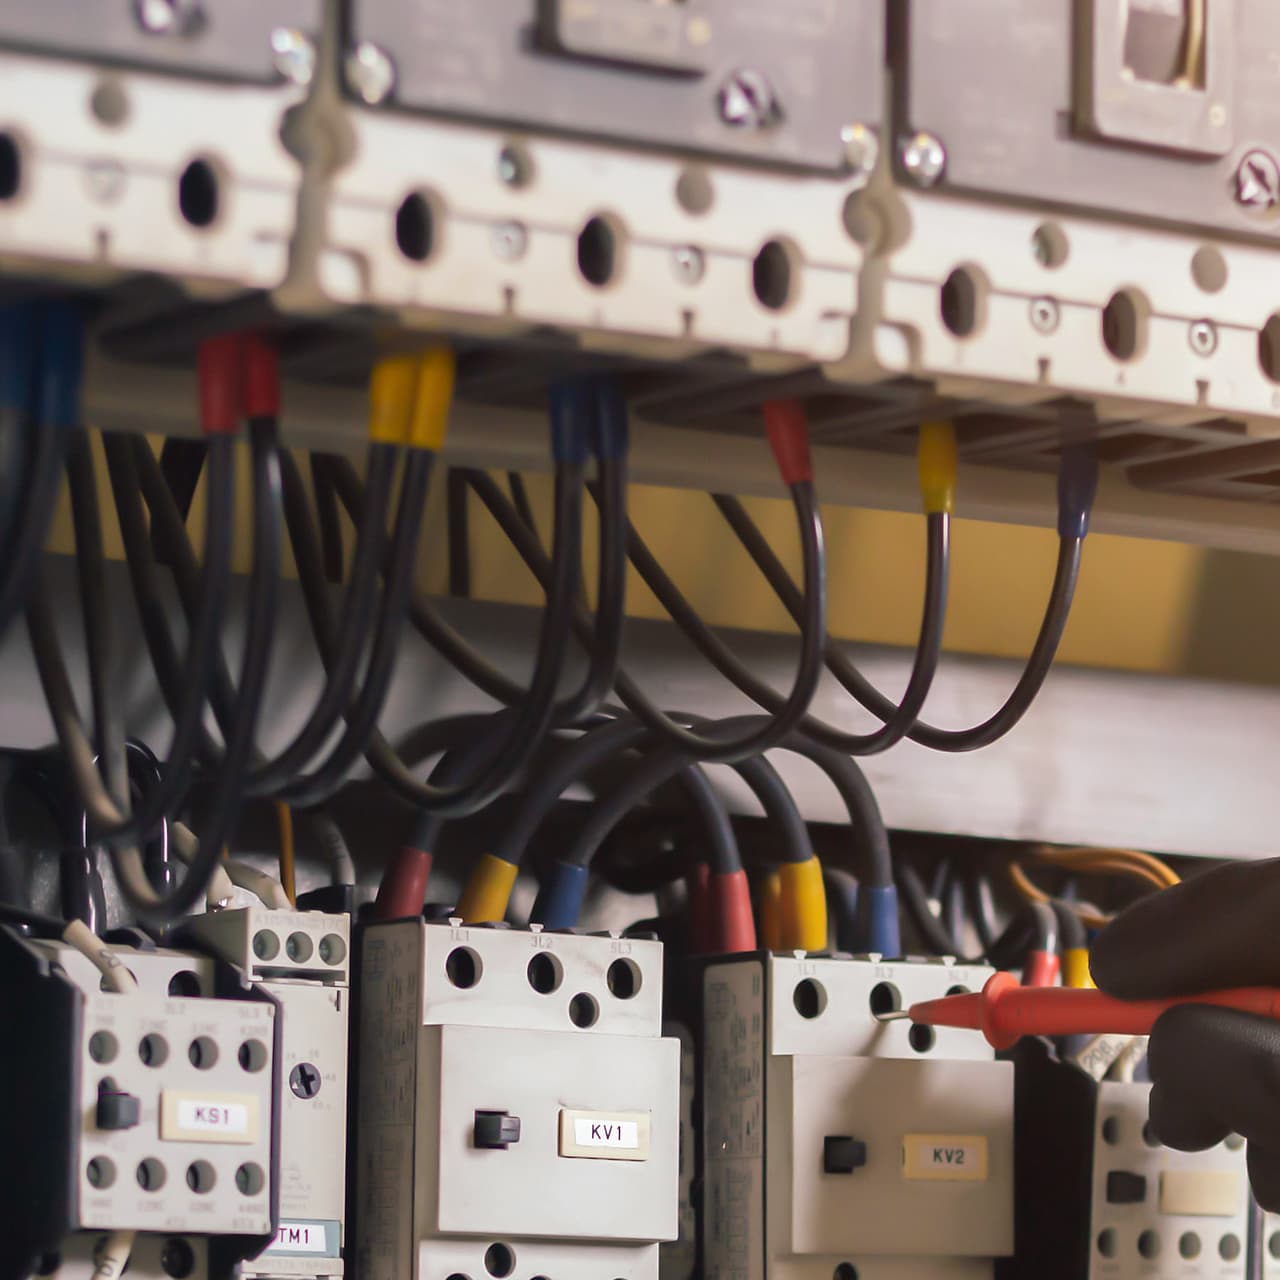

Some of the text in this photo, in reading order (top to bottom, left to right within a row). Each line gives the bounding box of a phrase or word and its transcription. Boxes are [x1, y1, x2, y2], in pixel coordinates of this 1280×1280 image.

[194, 1107, 230, 1124] KS1
[591, 1123, 622, 1141] KV1
[932, 1148, 966, 1165] KV2
